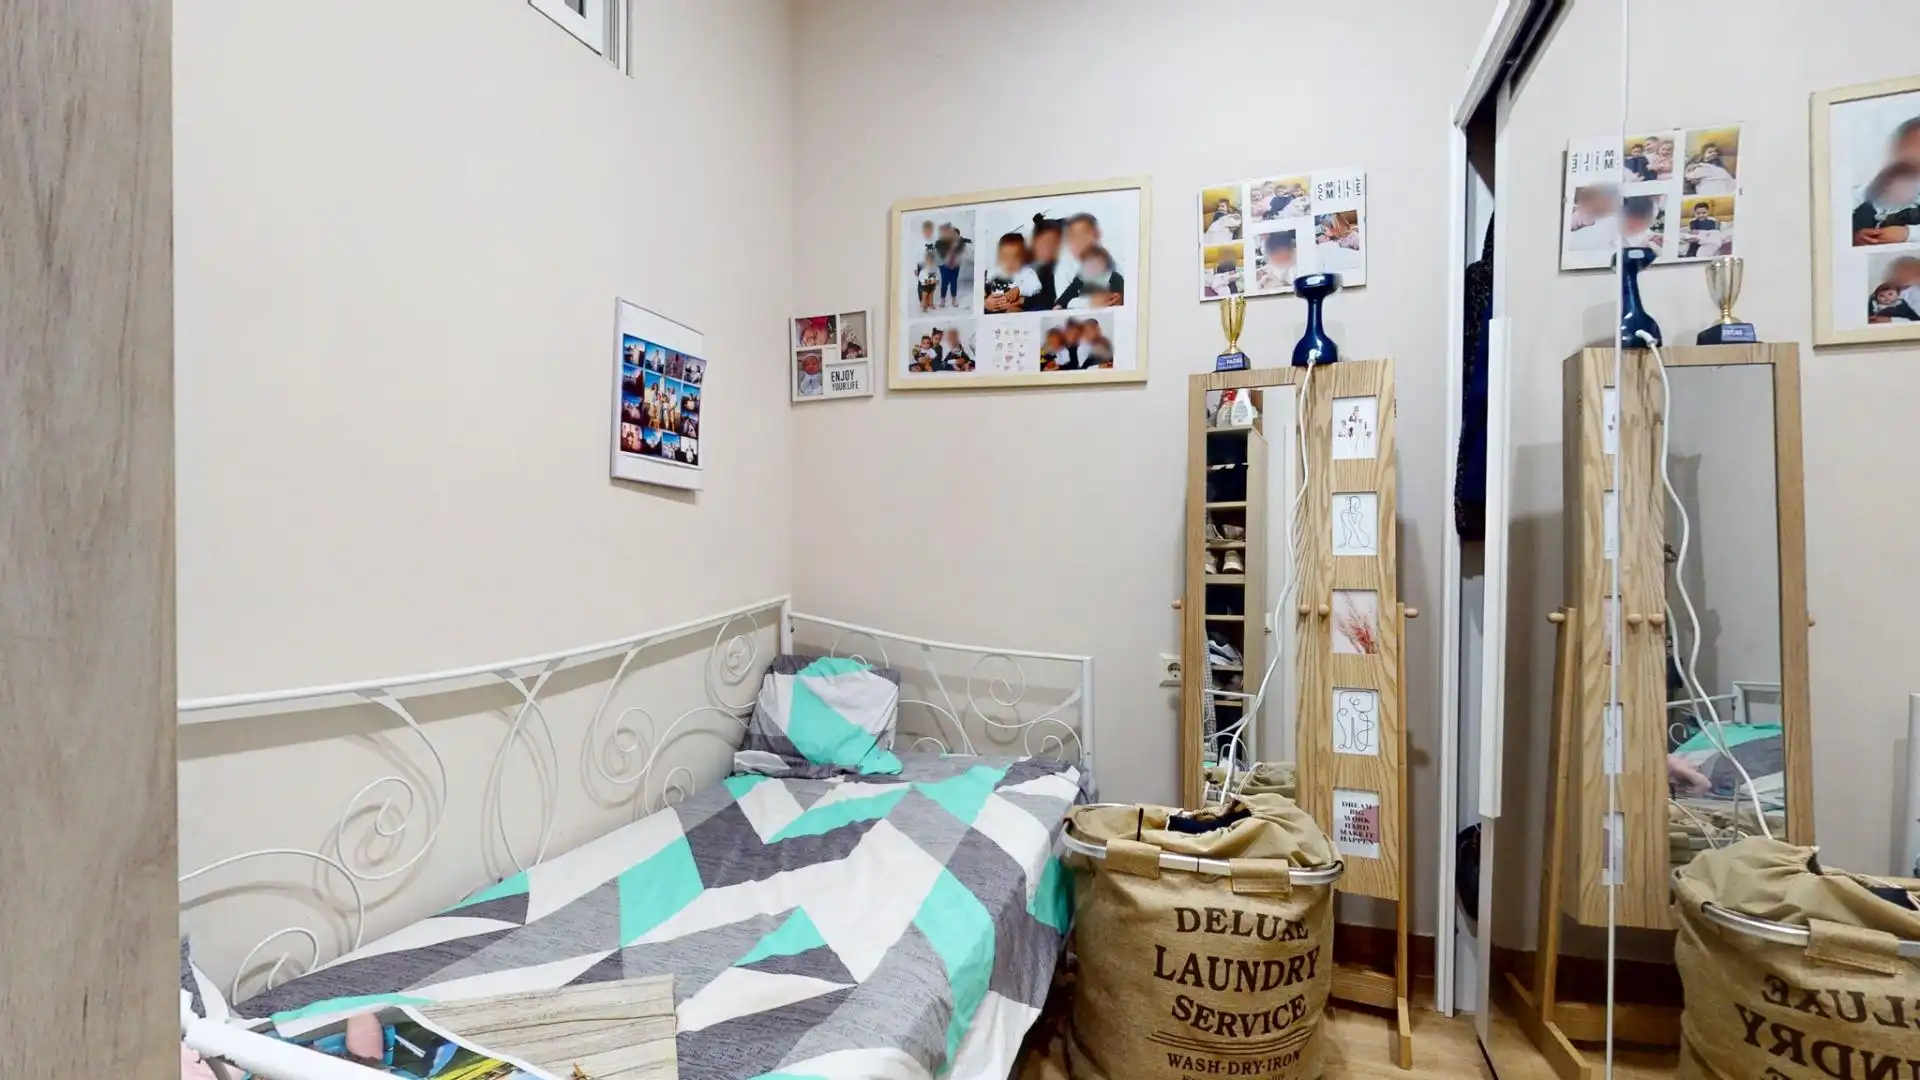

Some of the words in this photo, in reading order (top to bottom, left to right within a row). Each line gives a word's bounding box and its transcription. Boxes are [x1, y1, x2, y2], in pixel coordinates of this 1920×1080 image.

[830, 369, 855, 382] ENJOY
[832, 382, 846, 391] YOUR
[846, 380, 859, 389] LIFE
[1341, 801, 1372, 810] DREAM
[1344, 815, 1370, 824] WORK
[1344, 822, 1370, 831] HARD
[1340, 829, 1365, 838] MAKE
[1340, 835, 1374, 845] HAPPEN
[1153, 944, 1321, 993] LAUNDRY
[1171, 993, 1307, 1038] SERVICE
